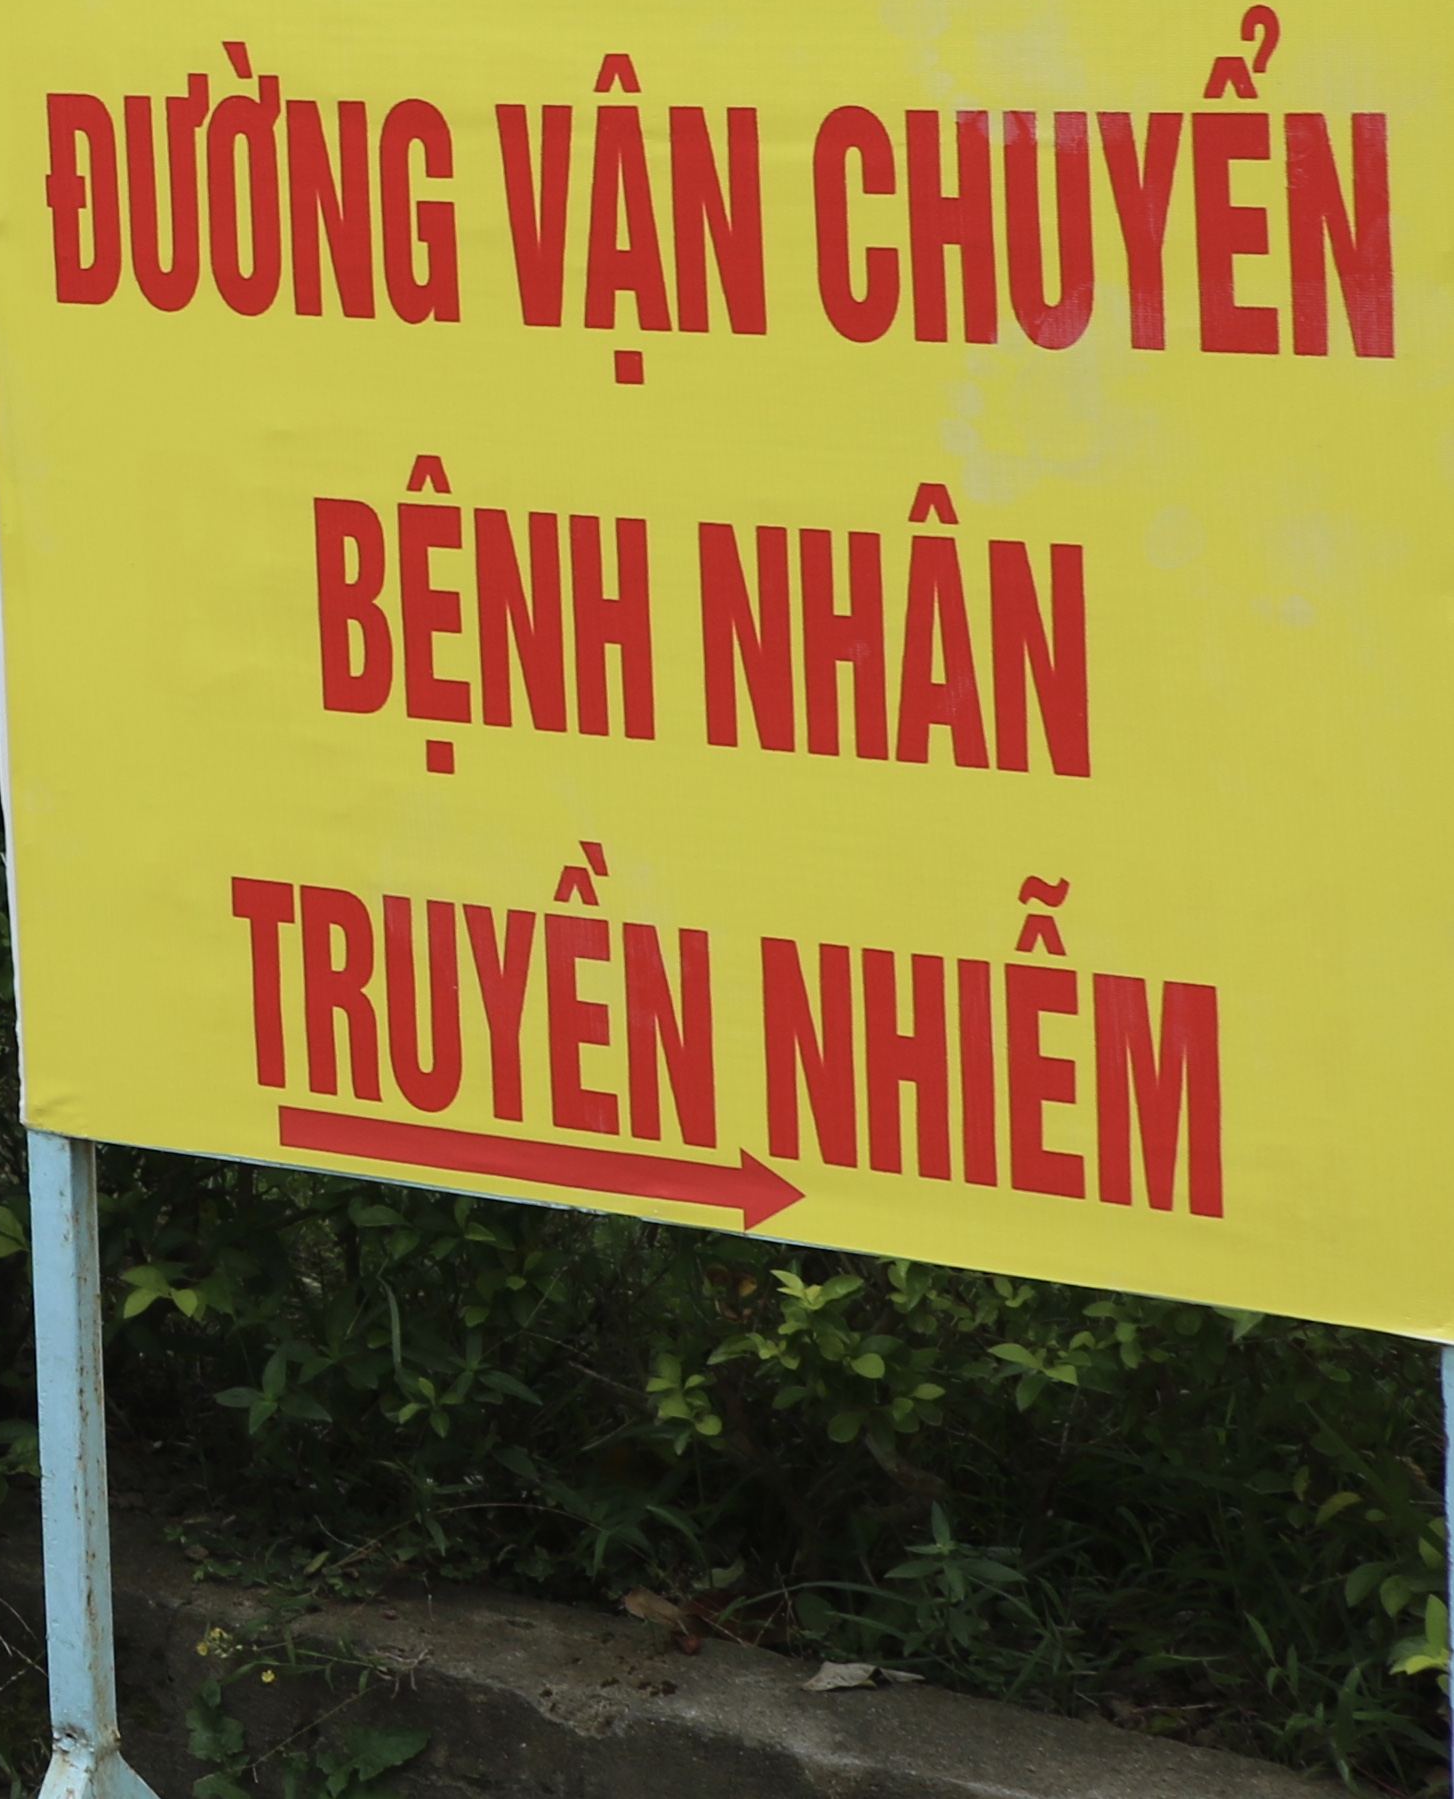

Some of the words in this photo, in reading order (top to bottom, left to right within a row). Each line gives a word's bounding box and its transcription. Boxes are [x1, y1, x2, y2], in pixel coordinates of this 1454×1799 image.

[46, 42, 460, 324] ĐƯỜNG
[497, 54, 767, 384] VẬN
[814, 6, 1395, 359] CHUYỂN
[314, 456, 655, 774] BỆNH
[699, 484, 1091, 778] NHÂN
[232, 841, 717, 1149] TRUYỀN
[762, 876, 1224, 1218] NHIỄM
